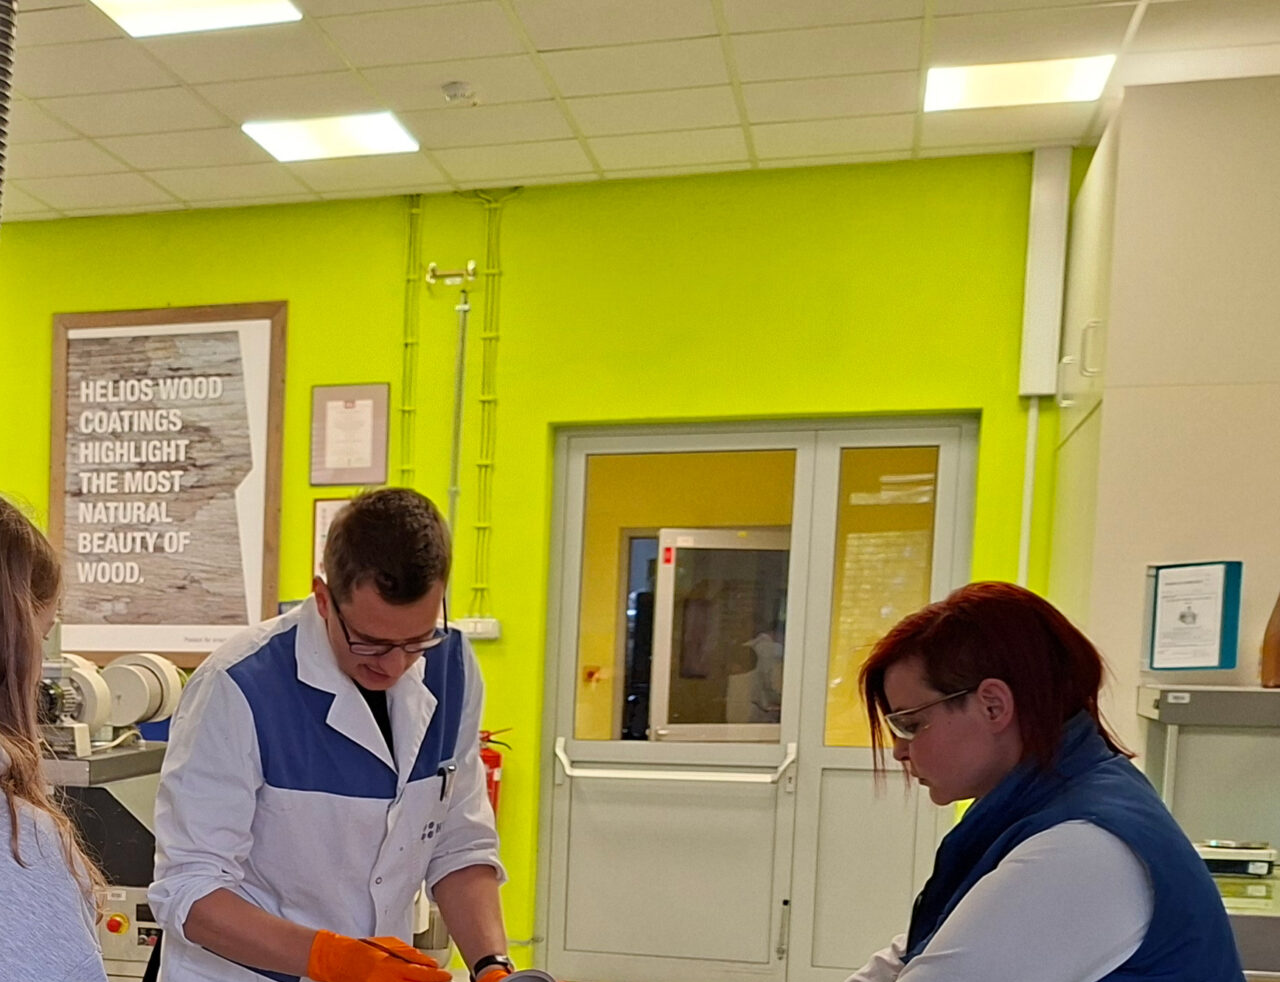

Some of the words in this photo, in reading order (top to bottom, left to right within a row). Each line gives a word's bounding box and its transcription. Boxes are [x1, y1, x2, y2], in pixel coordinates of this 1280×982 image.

[80, 380, 153, 403] HELIOS
[159, 376, 223, 400] WOOD
[80, 408, 183, 434] COATINGS
[79, 439, 189, 464] HIGHLIGHT
[79, 471, 119, 494] THE
[124, 469, 185, 493] MOST
[78, 500, 173, 524] NATURAL
[77, 531, 161, 554] BEAUTY
[164, 530, 191, 553] OF
[77, 561, 145, 585] WOOD.
